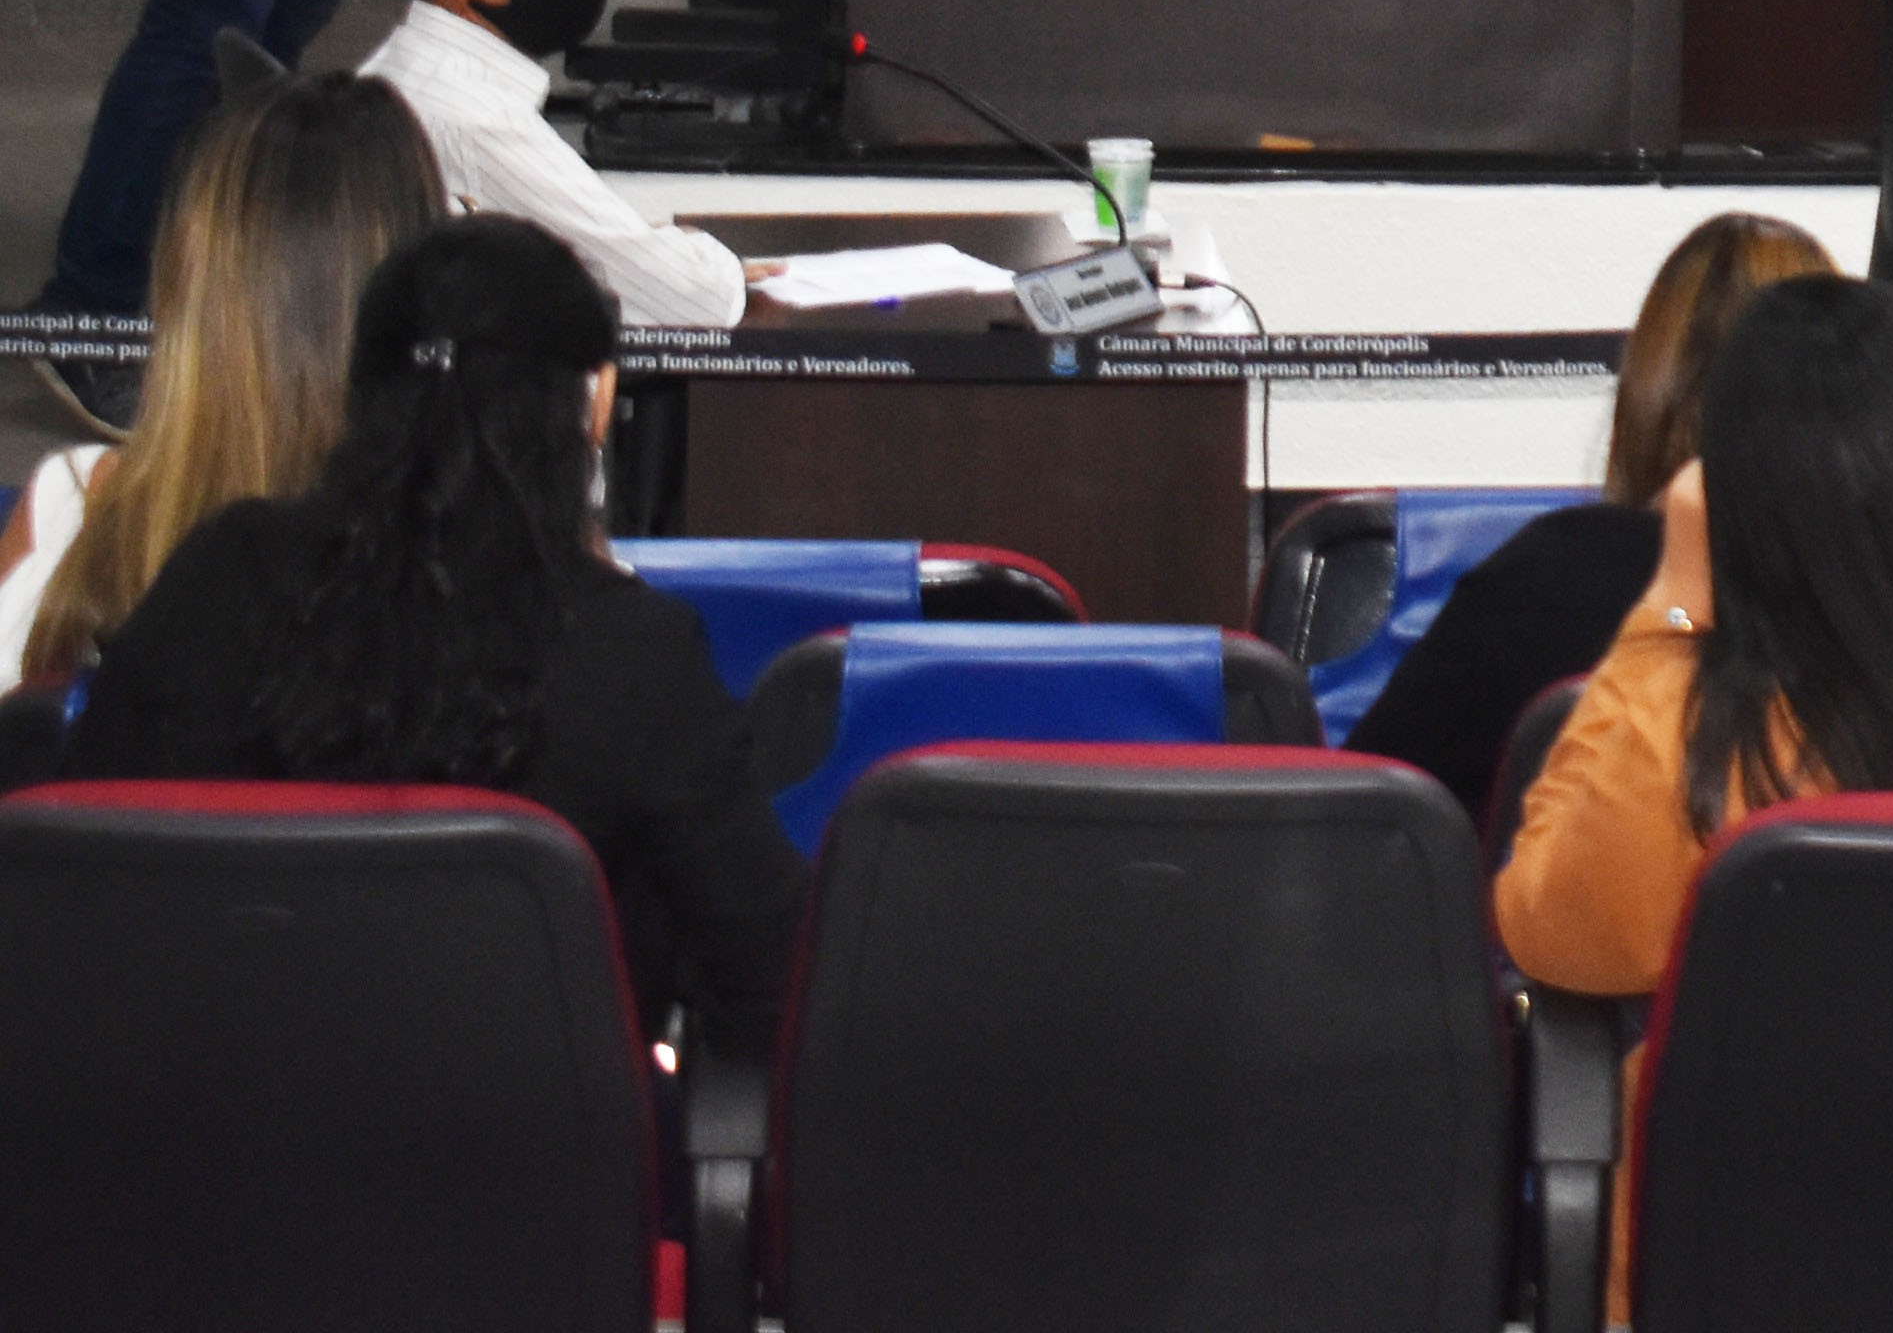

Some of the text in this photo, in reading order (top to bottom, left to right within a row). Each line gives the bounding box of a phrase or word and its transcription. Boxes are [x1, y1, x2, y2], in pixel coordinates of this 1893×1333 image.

[78, 313, 101, 331] de
[50, 341, 115, 359] apenas
[119, 342, 155, 361] par
[1100, 334, 1430, 357] Câmara Municipal de Cordeirópolis
[662, 351, 783, 373] funcionários
[787, 357, 799, 372] e
[802, 352, 917, 375] Vereadores.
[1099, 358, 1612, 380] Acesso restrito apenas para funcionários e Vereadores.
